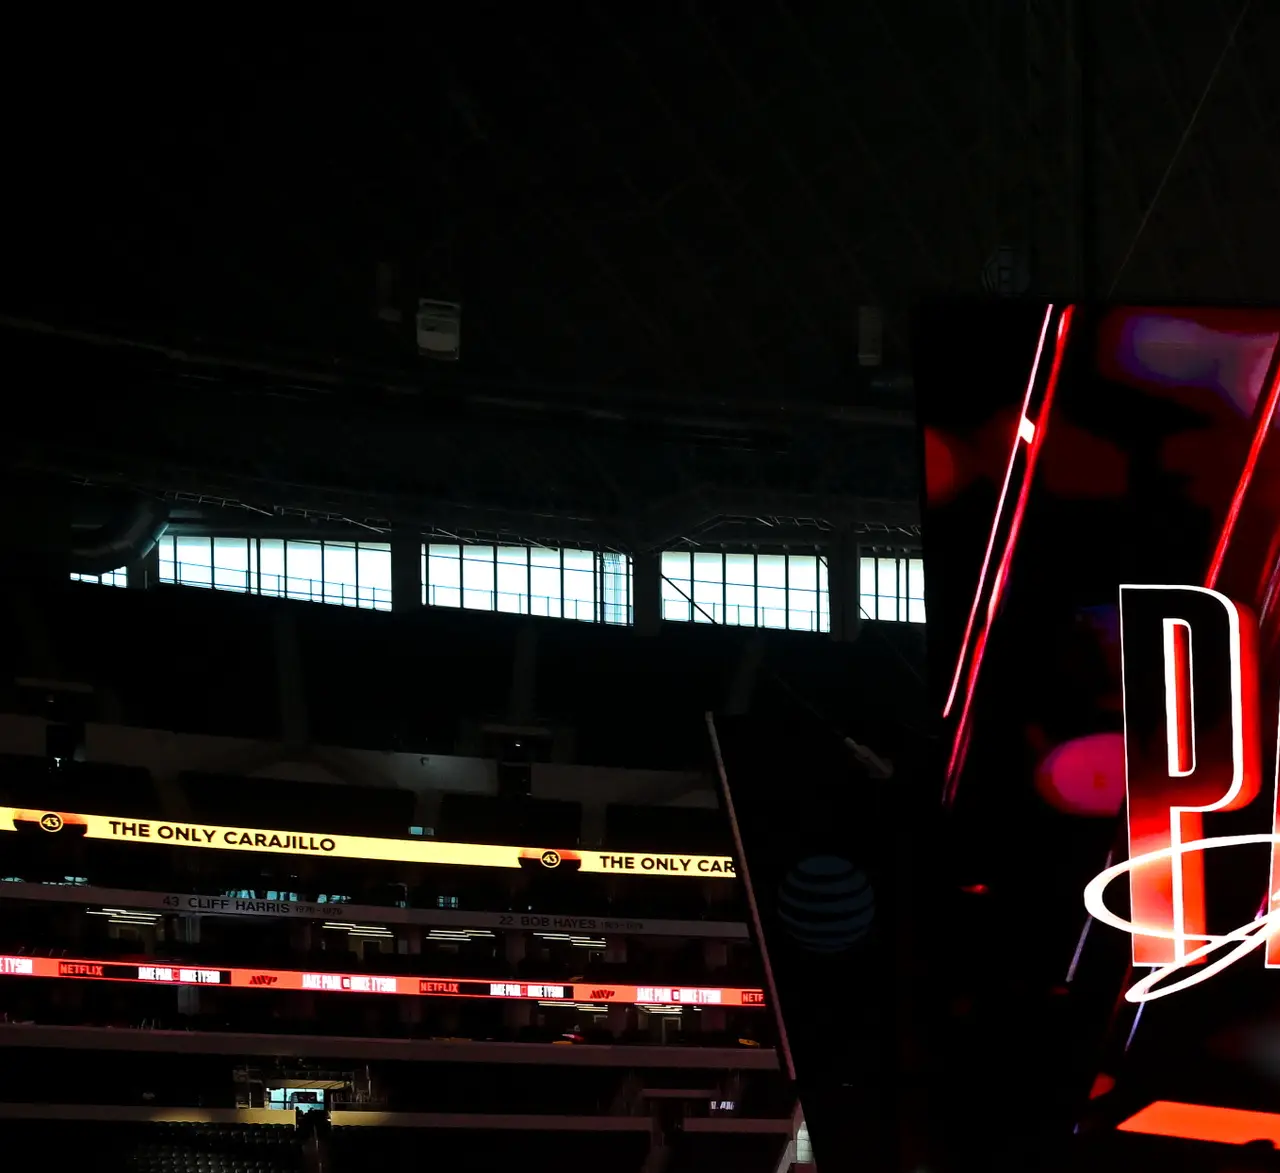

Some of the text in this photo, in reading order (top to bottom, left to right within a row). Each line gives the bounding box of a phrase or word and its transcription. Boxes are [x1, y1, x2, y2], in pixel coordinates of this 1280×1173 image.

[43, 816, 60, 828] 43
[109, 821, 335, 851] THE ONLY CARAJILLO
[543, 853, 558, 864] 43
[600, 856, 634, 869] THE
[641, 857, 691, 872] ONLY
[163, 896, 289, 914] 43 CLIFF HARRIS
[499, 918, 513, 926] 22
[521, 918, 549, 927] BOB
[554, 918, 596, 929] HAYES
[61, 963, 103, 976] NETFLIX
[420, 982, 458, 993] NETFLIX
